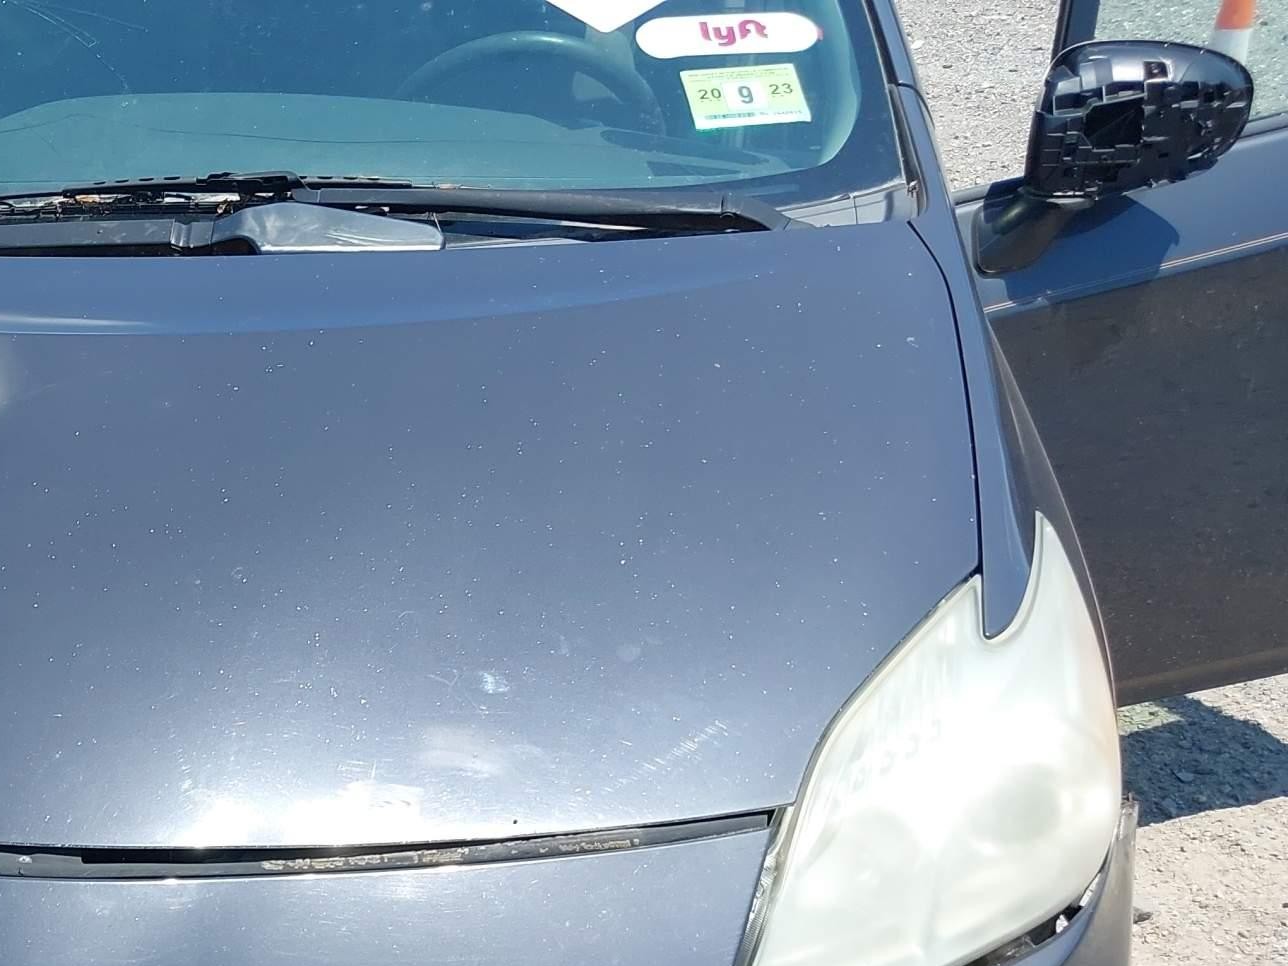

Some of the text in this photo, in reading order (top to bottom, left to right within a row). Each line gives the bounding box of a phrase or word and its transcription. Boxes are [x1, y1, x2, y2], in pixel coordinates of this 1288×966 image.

[699, 19, 769, 47] lyft
[697, 83, 793, 104] 20 9 23
